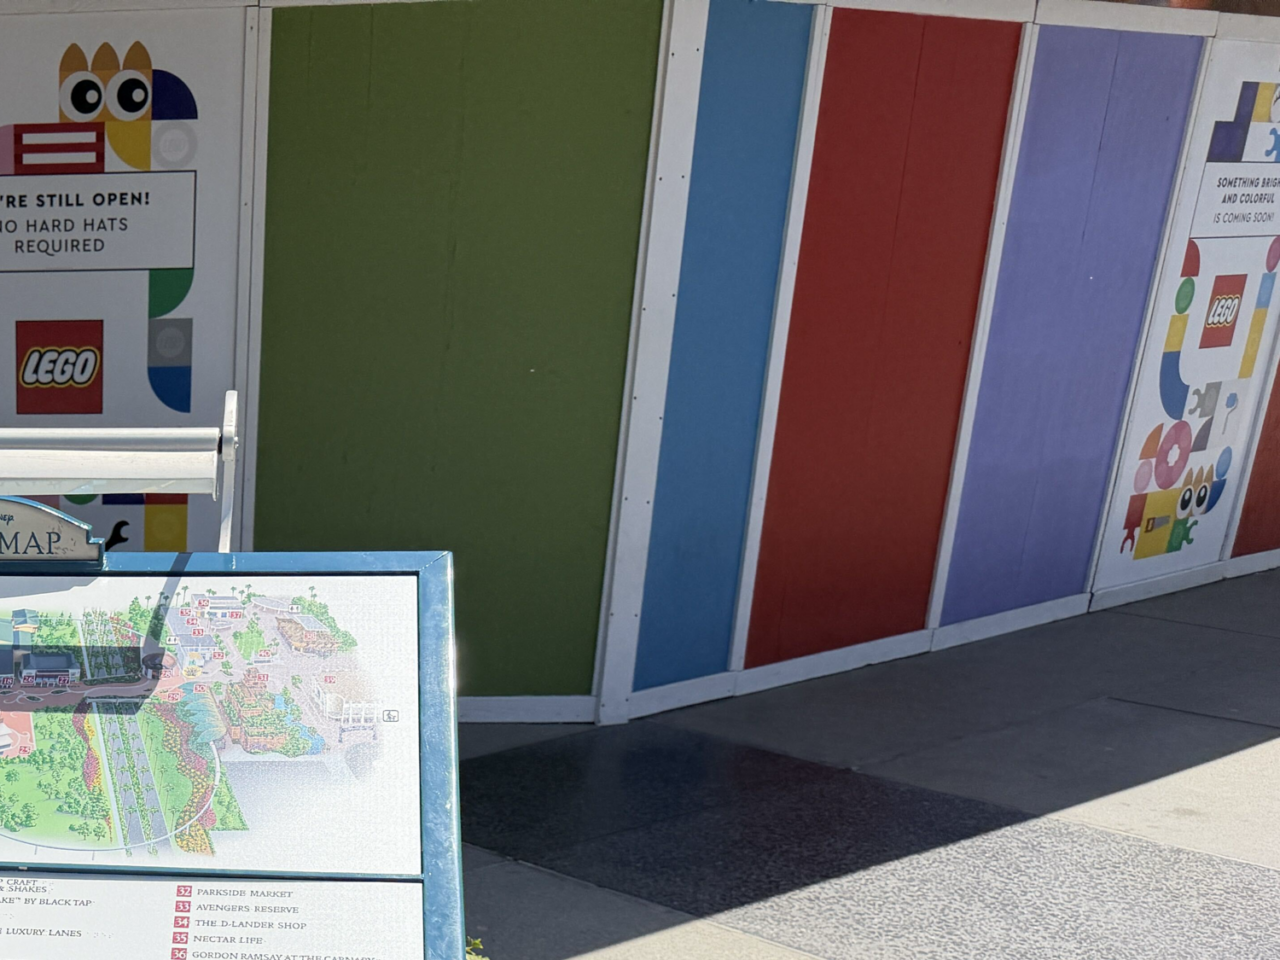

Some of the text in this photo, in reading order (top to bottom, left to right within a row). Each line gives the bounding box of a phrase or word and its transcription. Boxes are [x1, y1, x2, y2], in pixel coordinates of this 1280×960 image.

[1217, 177, 1259, 188] SOMETHING
[36, 194, 84, 207] STILL
[93, 192, 150, 206] OPEN!
[1222, 193, 1274, 203] AND COLORFUL
[1213, 213, 1221, 223] IS
[1223, 213, 1251, 223] COMING
[27, 219, 75, 233] HARD
[84, 218, 128, 231] HATS
[15, 239, 105, 256] REQUIRED
[1206, 296, 1240, 326] LEGO
[22, 349, 97, 385] LEGO
[178, 887, 190, 896] 32
[177, 902, 189, 911] 33
[6, 928, 44, 936] LUXURY
[48, 929, 82, 937] LANES
